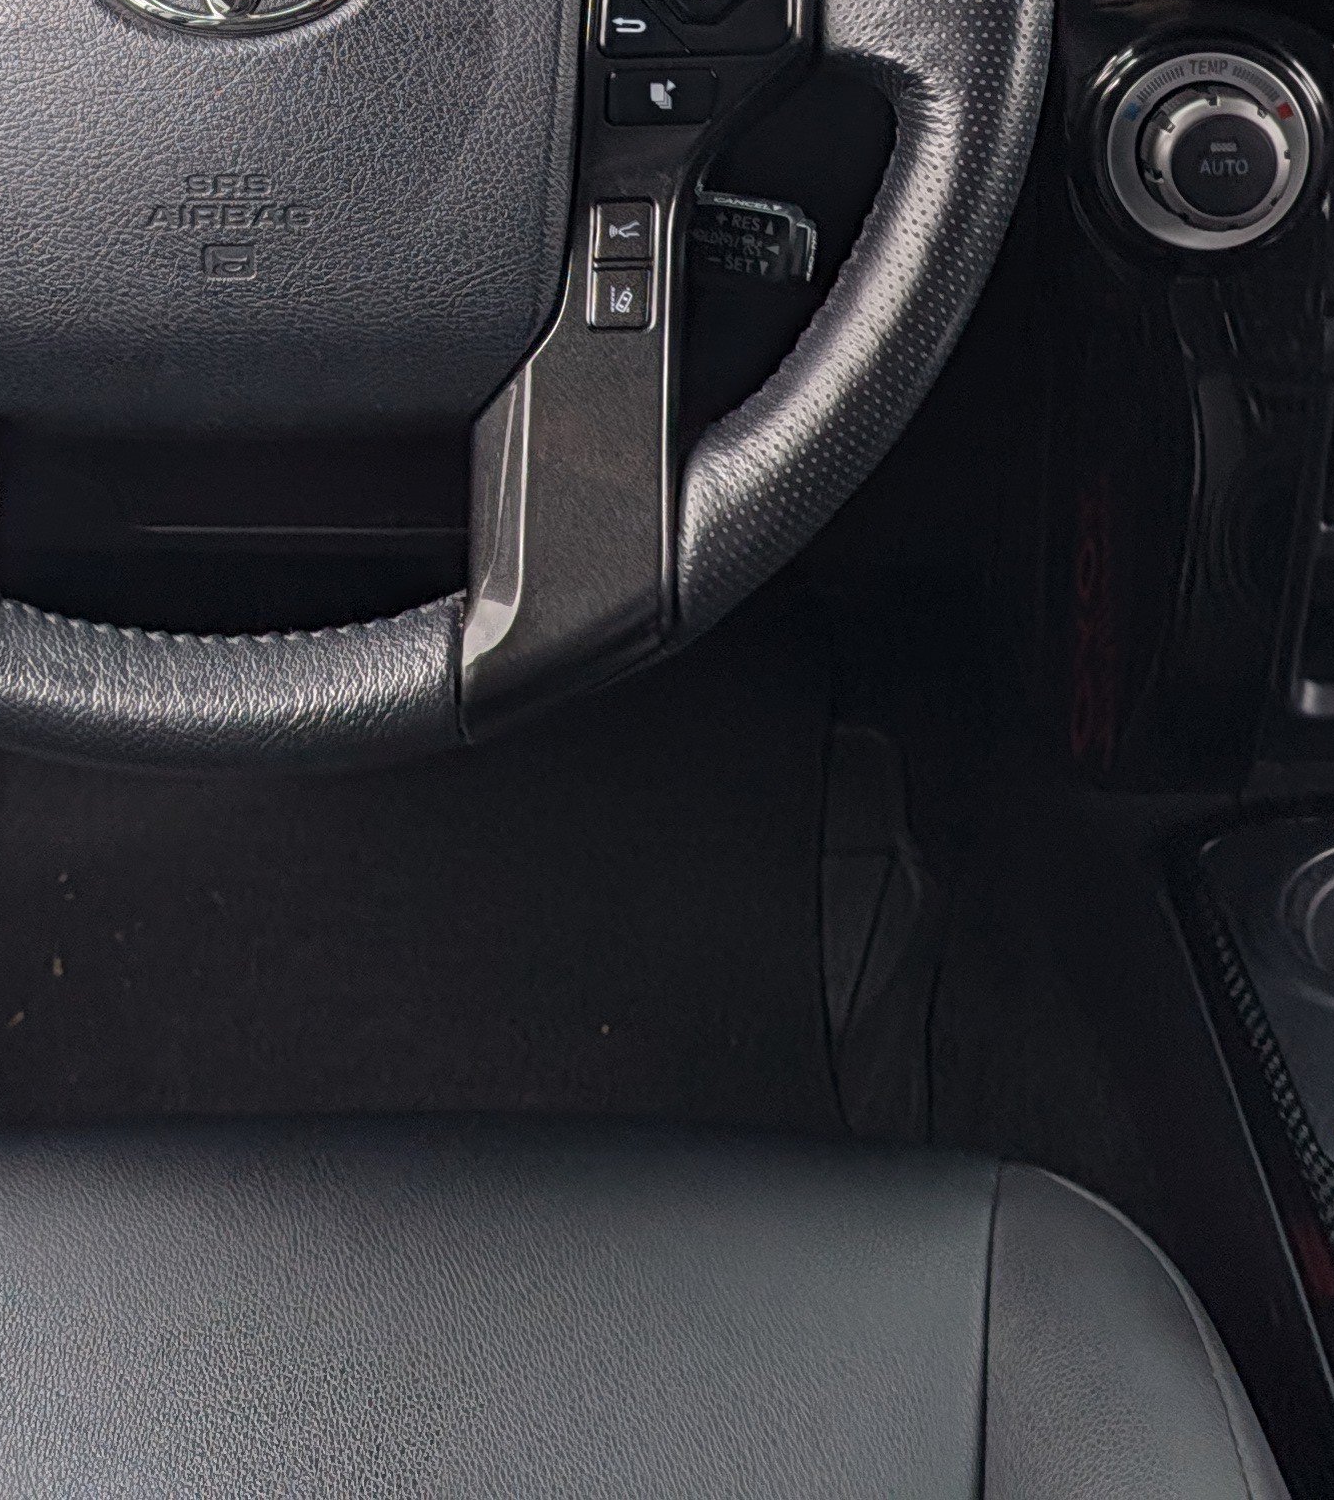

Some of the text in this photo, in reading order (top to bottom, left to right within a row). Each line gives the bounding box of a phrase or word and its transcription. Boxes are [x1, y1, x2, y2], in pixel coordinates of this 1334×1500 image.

[1188, 59, 1229, 76] TEMP
[1199, 159, 1249, 175] AUTO
[185, 174, 271, 198] SRS
[146, 204, 315, 229] AIRBAG
